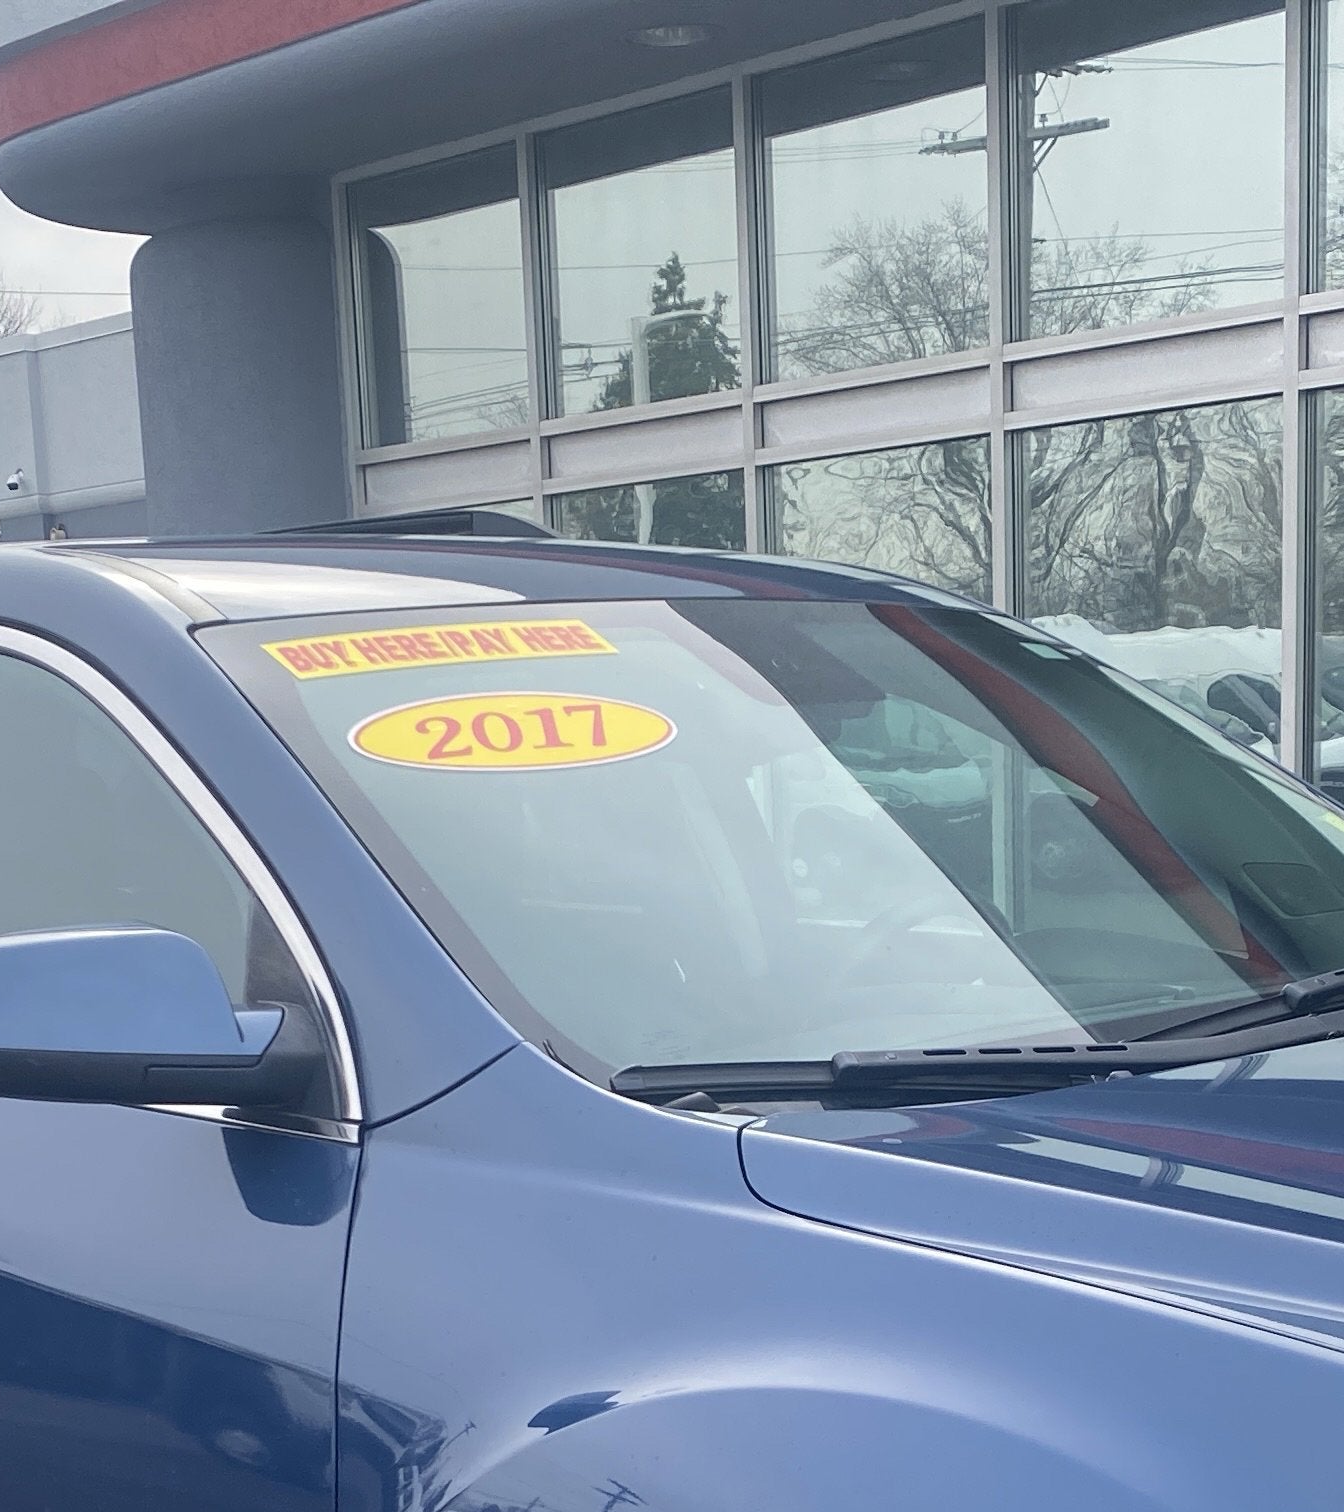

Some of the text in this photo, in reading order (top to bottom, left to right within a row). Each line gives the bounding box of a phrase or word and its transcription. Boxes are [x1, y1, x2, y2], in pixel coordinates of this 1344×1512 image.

[275, 640, 358, 673] BUY
[511, 625, 607, 652] HERE
[415, 704, 607, 761] 2017
